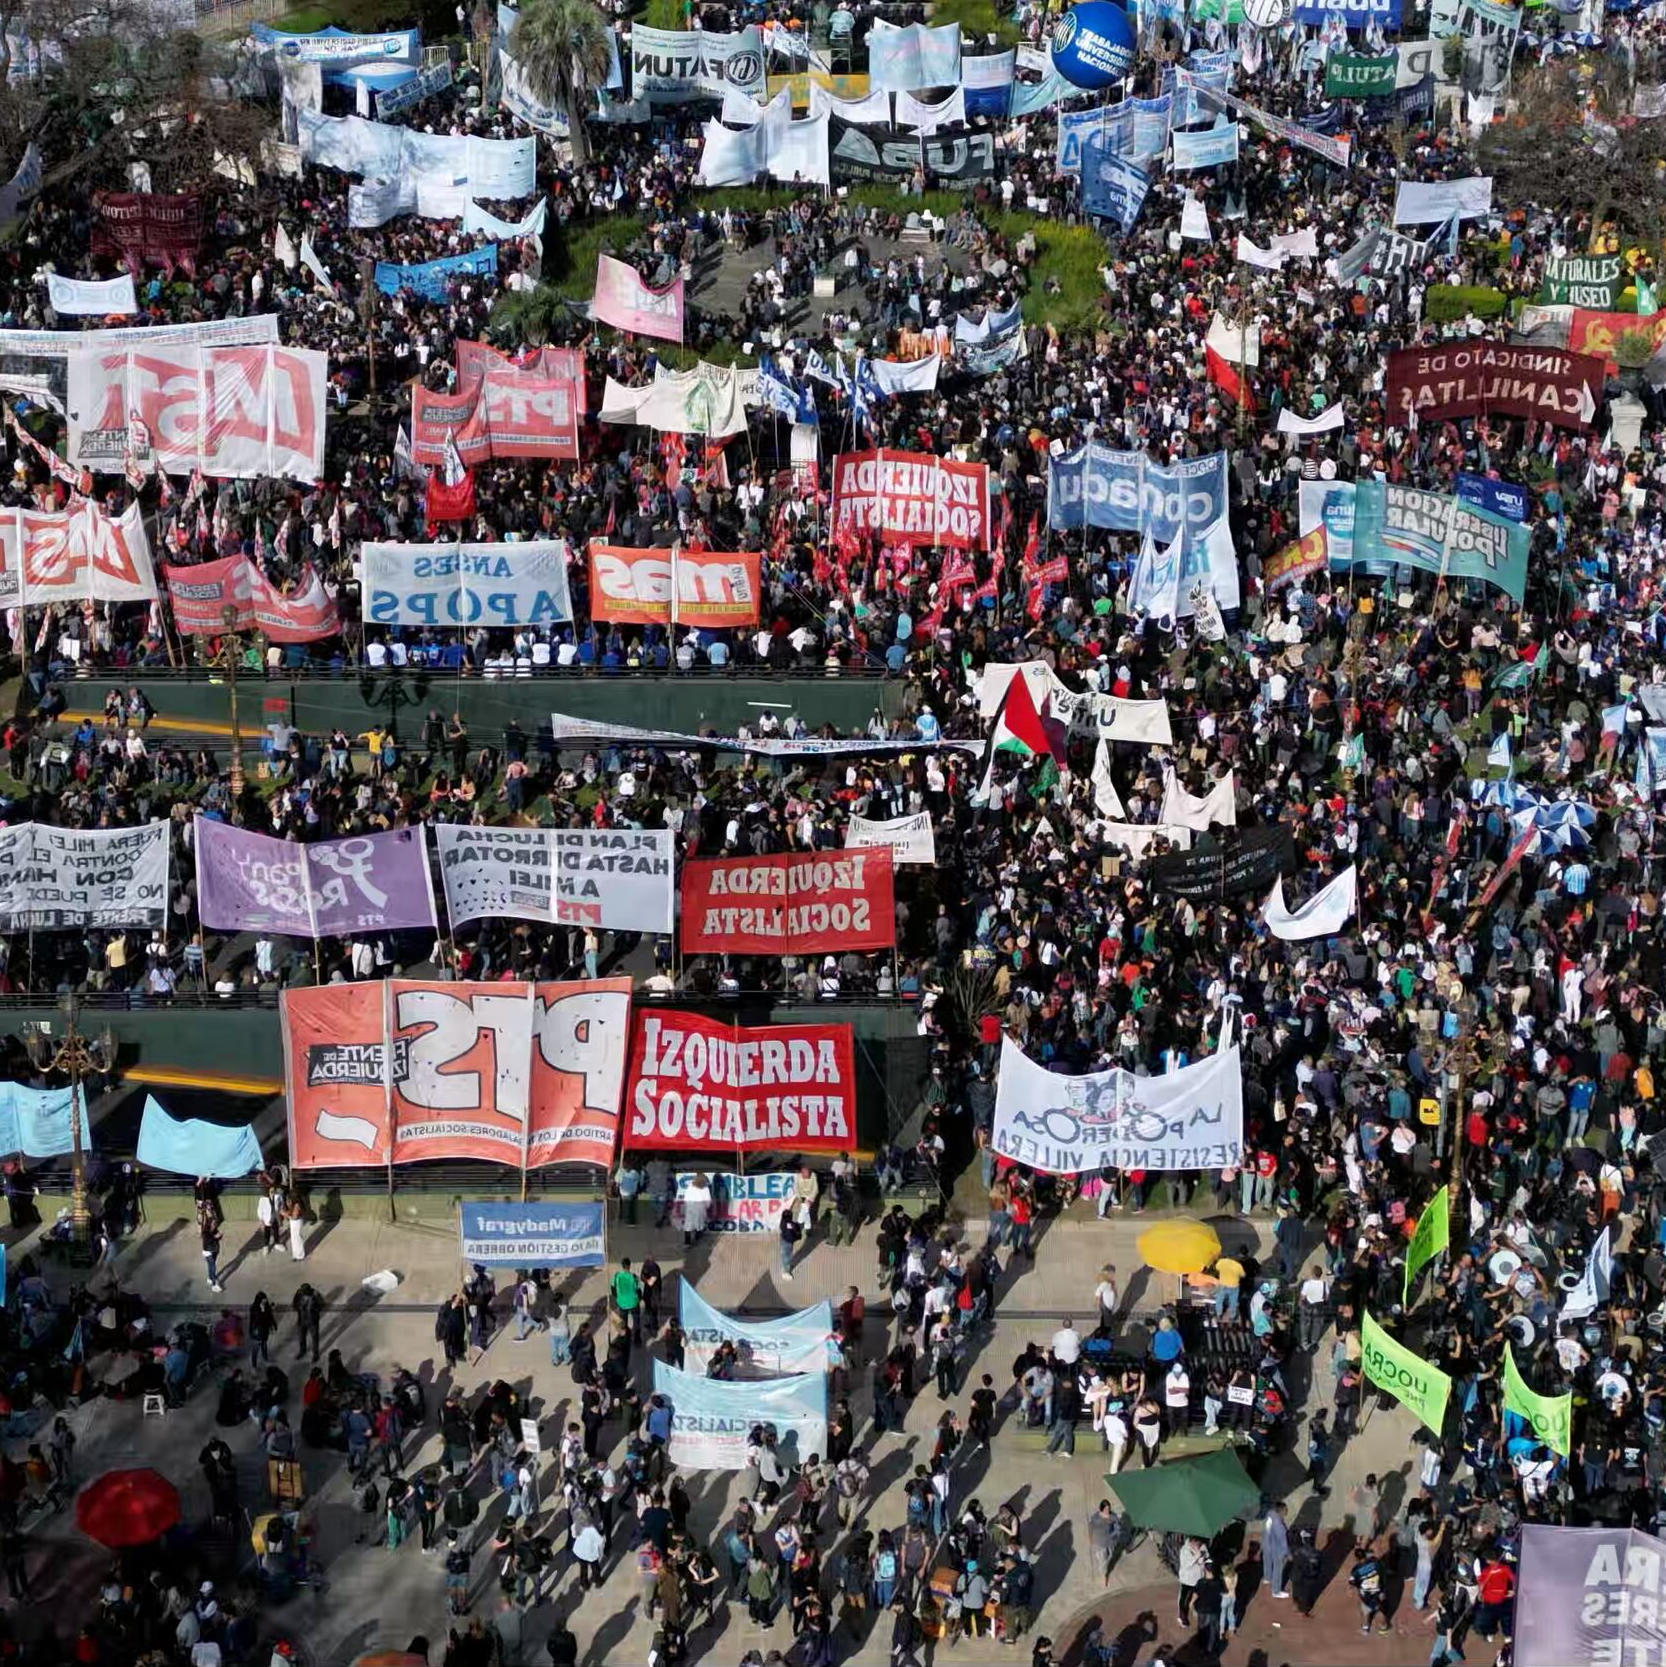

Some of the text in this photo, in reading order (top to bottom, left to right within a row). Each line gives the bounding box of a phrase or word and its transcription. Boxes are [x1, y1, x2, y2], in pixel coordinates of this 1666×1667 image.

[1569, 285, 1610, 308] USEO
[642, 1017, 841, 1090] IZQUIERDA
[633, 1079, 848, 1142] SOCIALISTA
